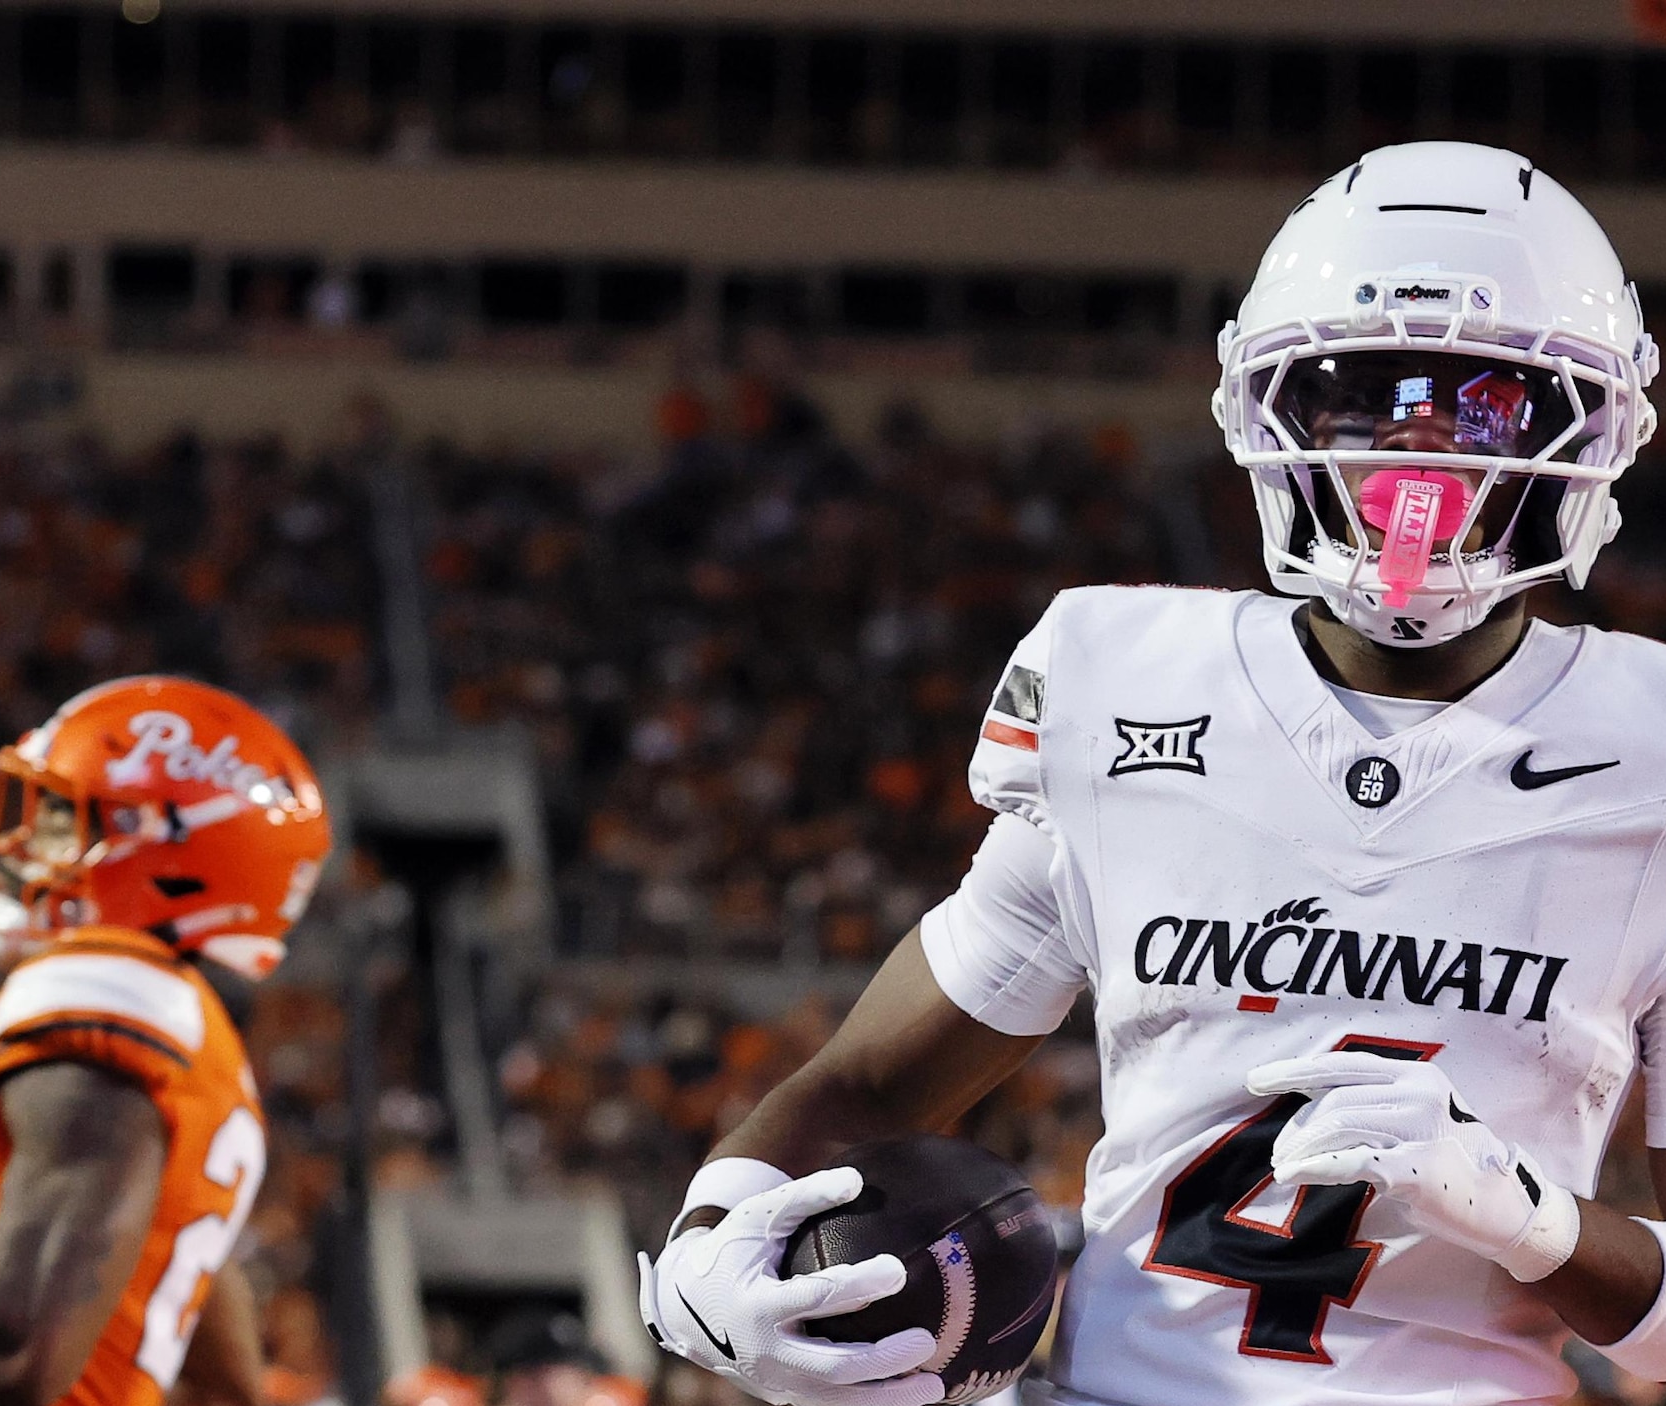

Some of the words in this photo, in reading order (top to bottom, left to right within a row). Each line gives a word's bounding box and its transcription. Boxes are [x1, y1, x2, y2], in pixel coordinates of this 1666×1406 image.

[1114, 719, 1204, 770] XII
[1357, 779, 1385, 802] 58
[1360, 761, 1387, 782] JK
[1134, 912, 1569, 1022] CINCINNATI
[1141, 1033, 1446, 1365] 4
